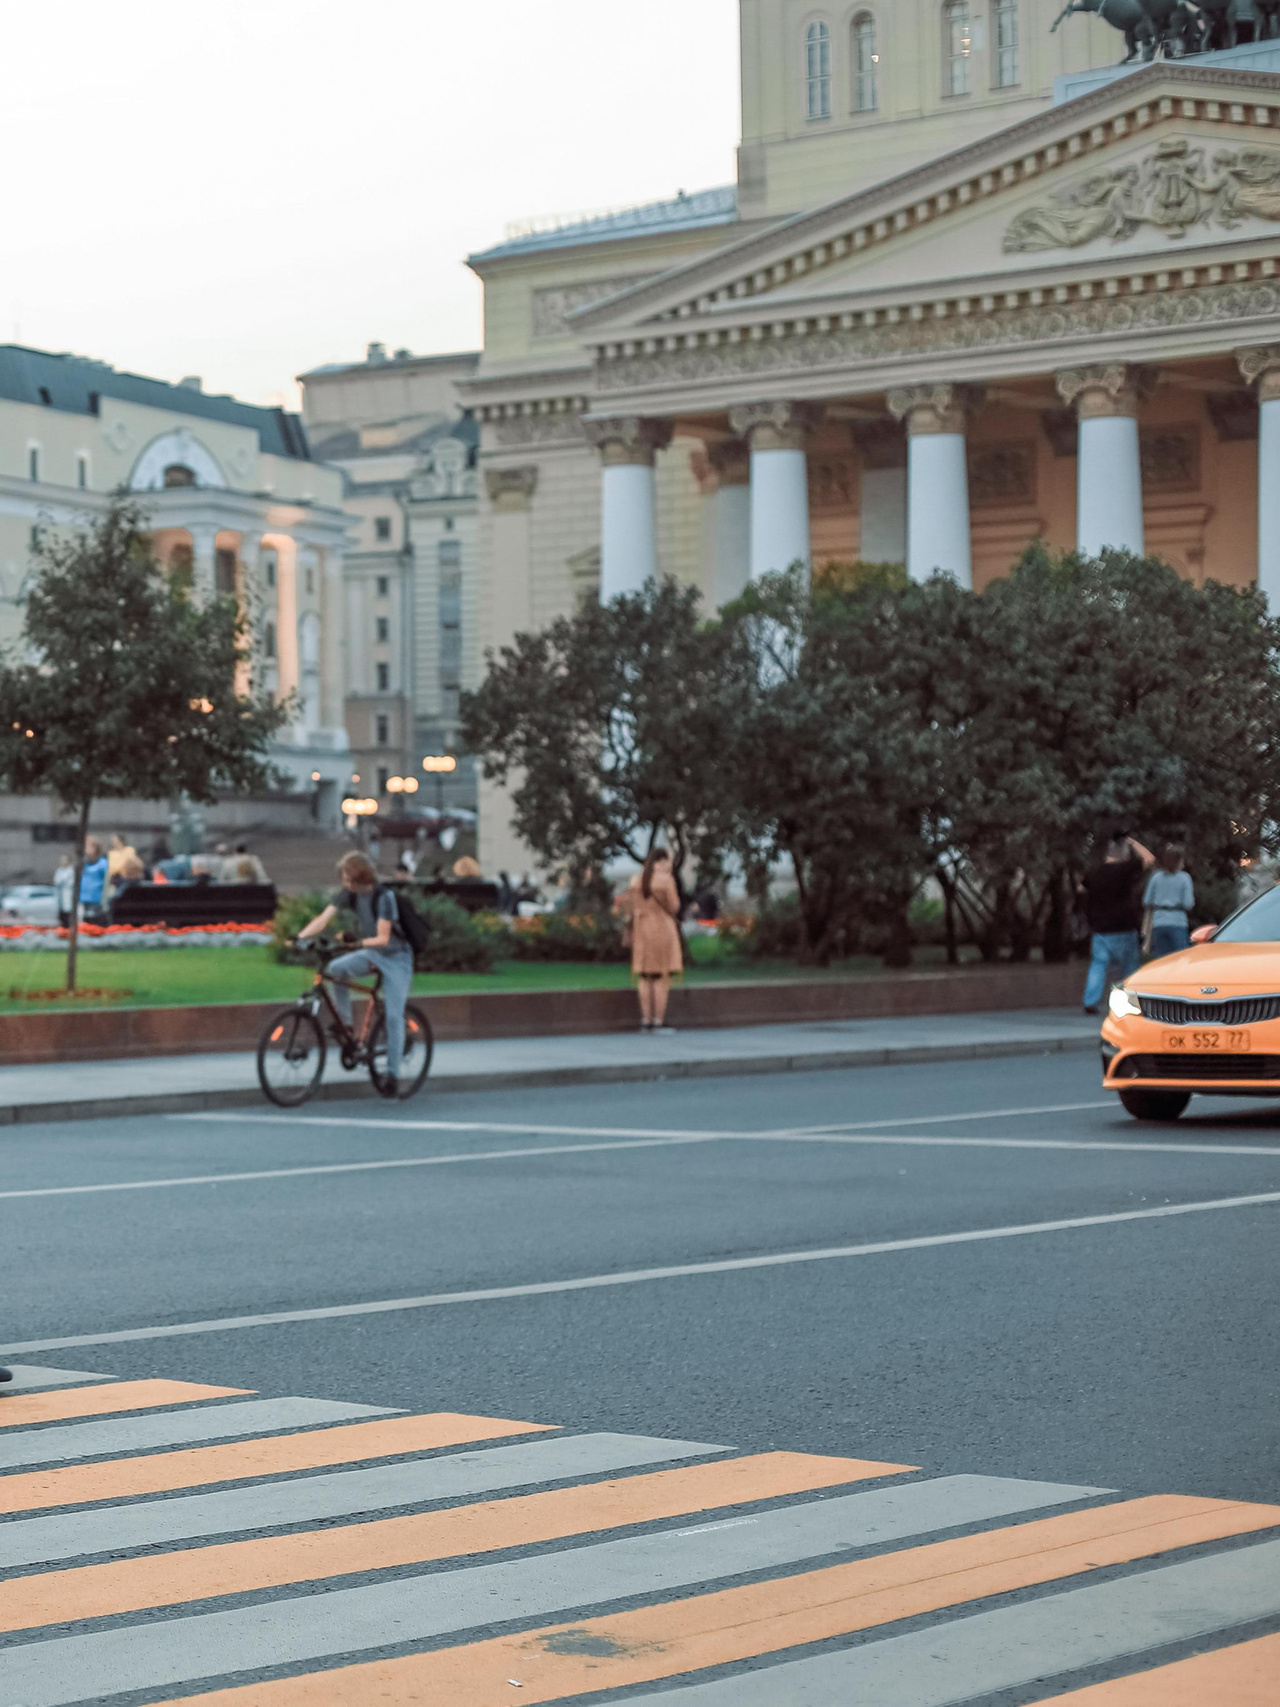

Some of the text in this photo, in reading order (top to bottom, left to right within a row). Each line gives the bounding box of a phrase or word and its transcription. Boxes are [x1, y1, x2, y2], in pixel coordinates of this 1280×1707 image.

[1169, 1031, 1244, 1048] OK 552 77
